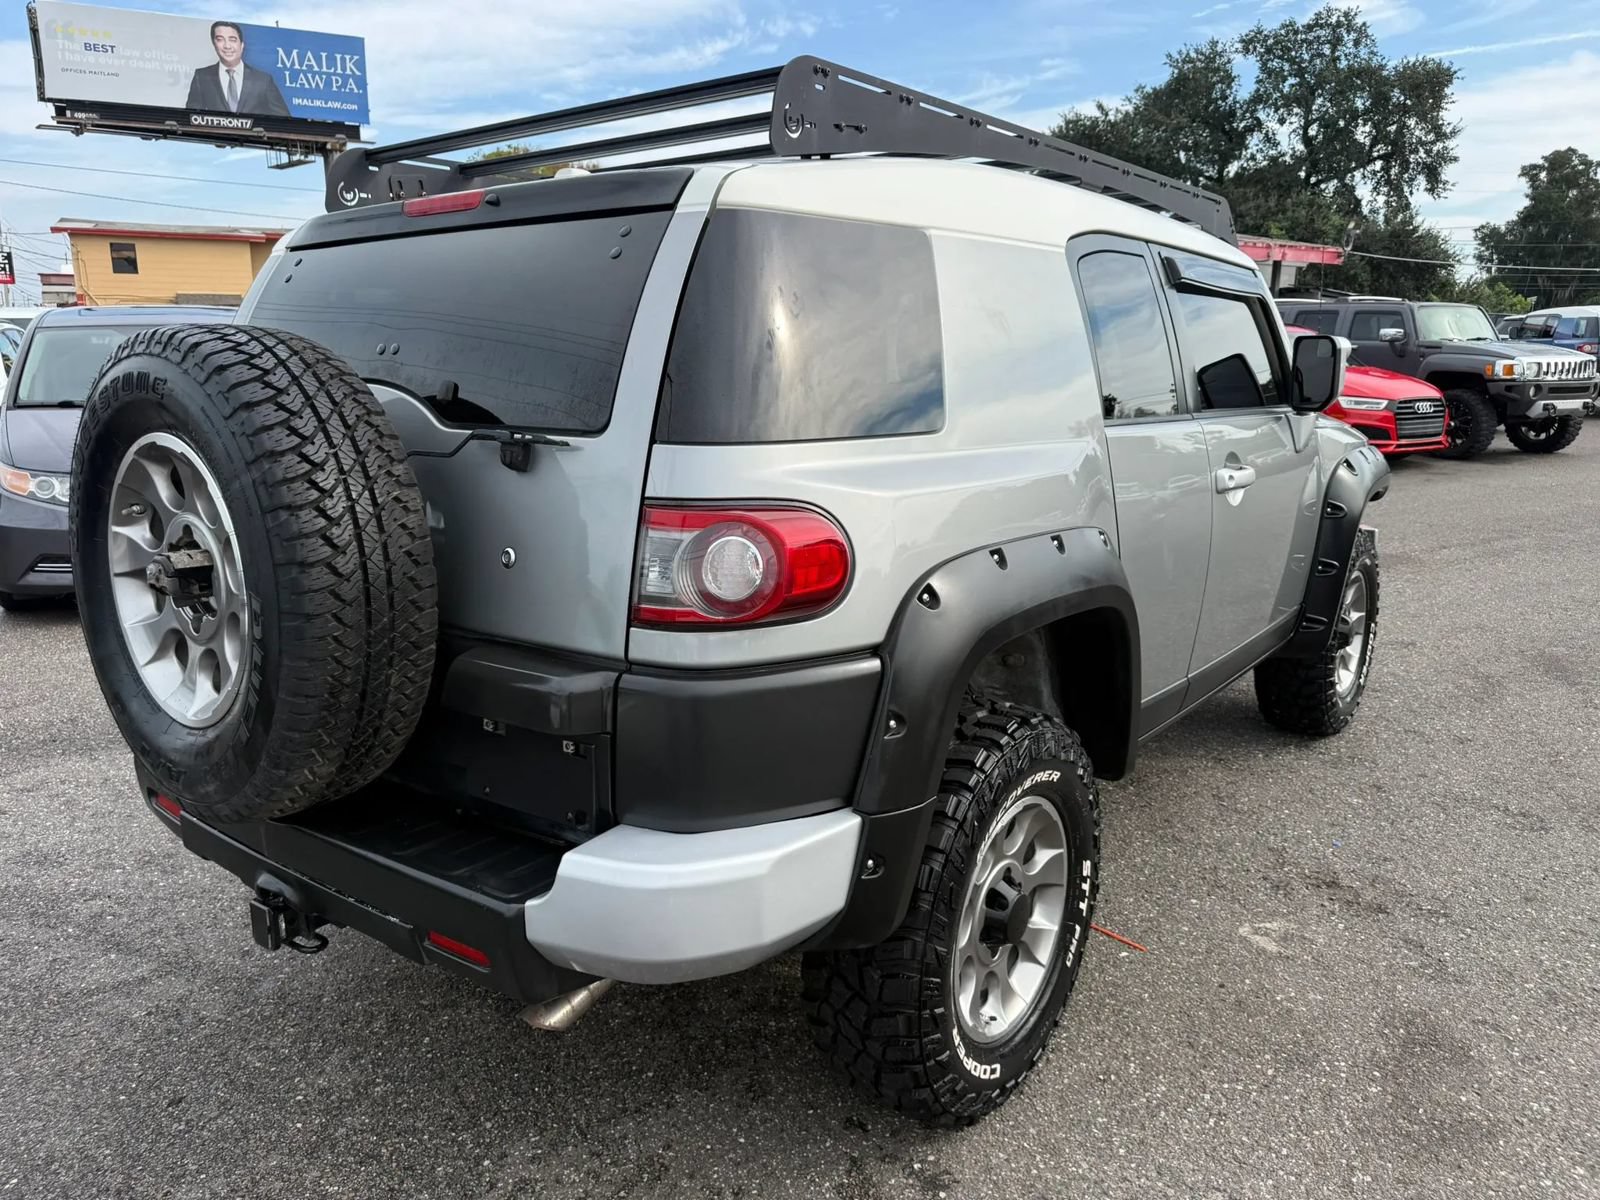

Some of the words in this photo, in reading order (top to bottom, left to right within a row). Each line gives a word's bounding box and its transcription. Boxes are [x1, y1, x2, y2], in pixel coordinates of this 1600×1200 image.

[65, 52, 95, 63] have
[99, 56, 126, 66] ever
[83, 42, 116, 54] BEST
[120, 47, 140, 58] law
[144, 48, 178, 61] office
[276, 47, 361, 75] MALIK
[61, 67, 87, 75] OFFICES
[88, 70, 120, 78] MAITLAND
[284, 71, 326, 90] LAW
[331, 76, 363, 93] P.A.
[1079, 859, 1092, 917] STT
[1065, 923, 1081, 968] PRO
